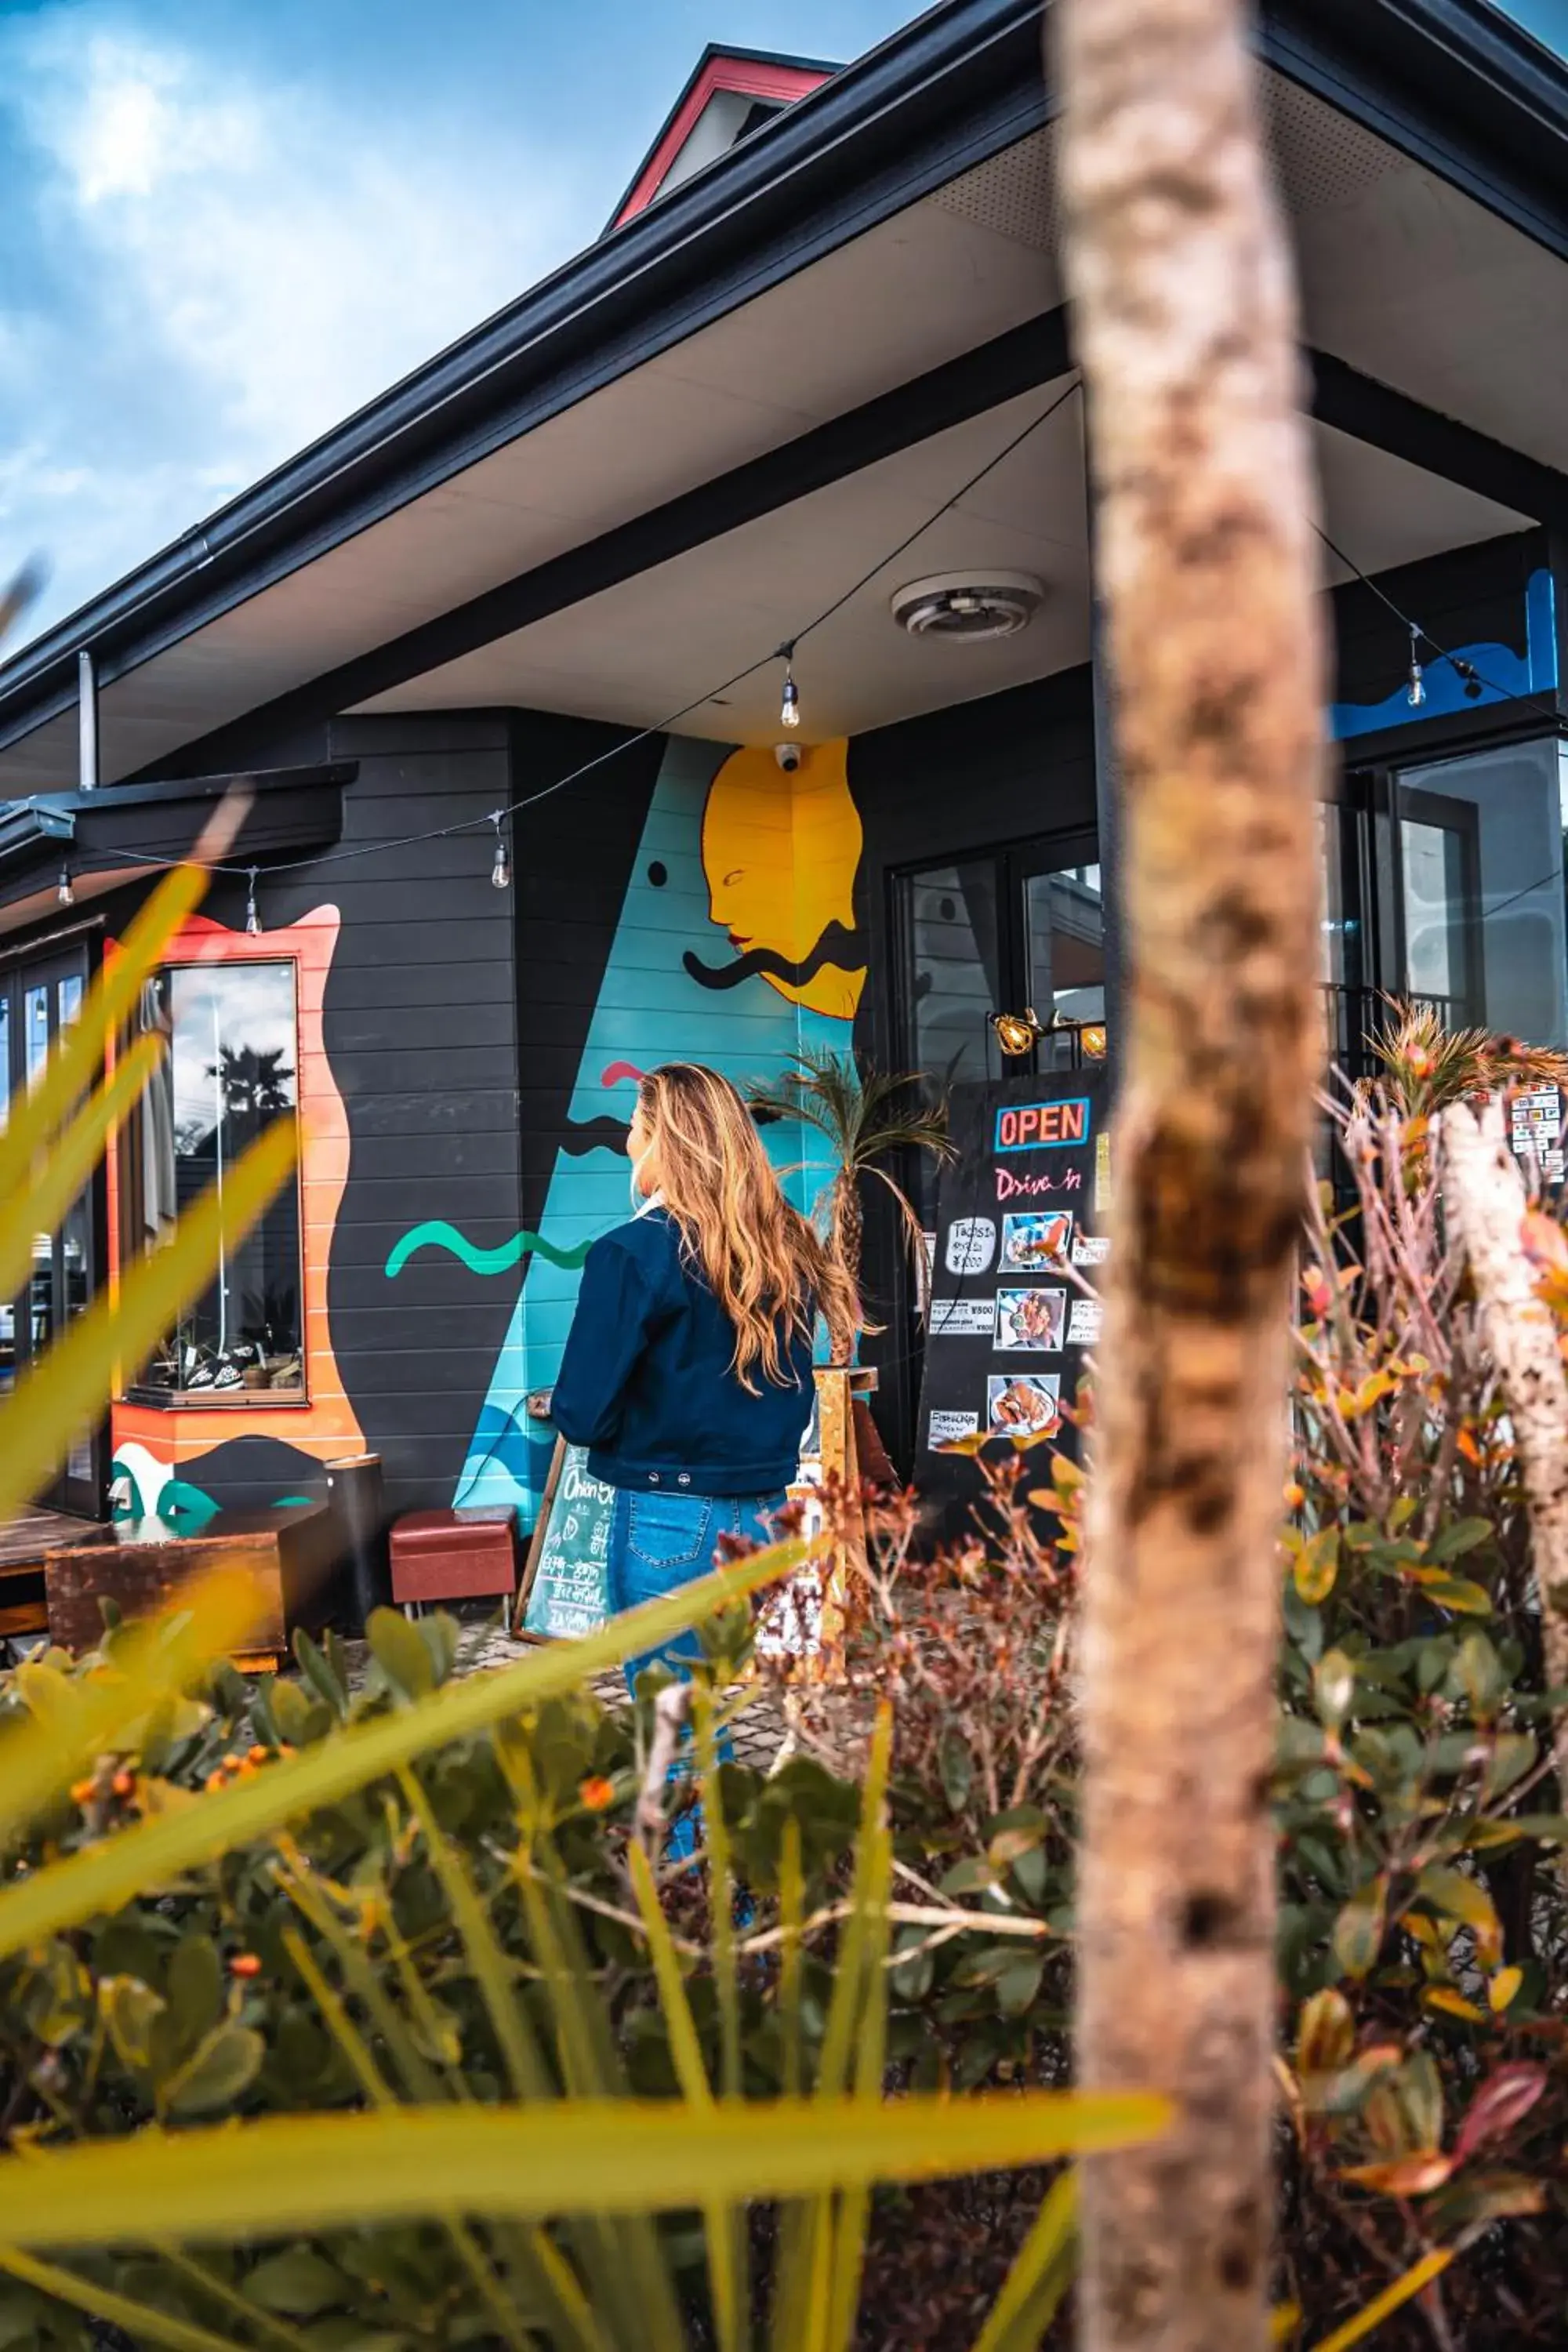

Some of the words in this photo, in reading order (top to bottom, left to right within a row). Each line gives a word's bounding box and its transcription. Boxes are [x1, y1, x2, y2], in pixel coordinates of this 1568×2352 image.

[1001, 1102, 1084, 1145] OPEN
[995, 1167, 1053, 1201] Drive
[564, 1468, 598, 1501] Onion
